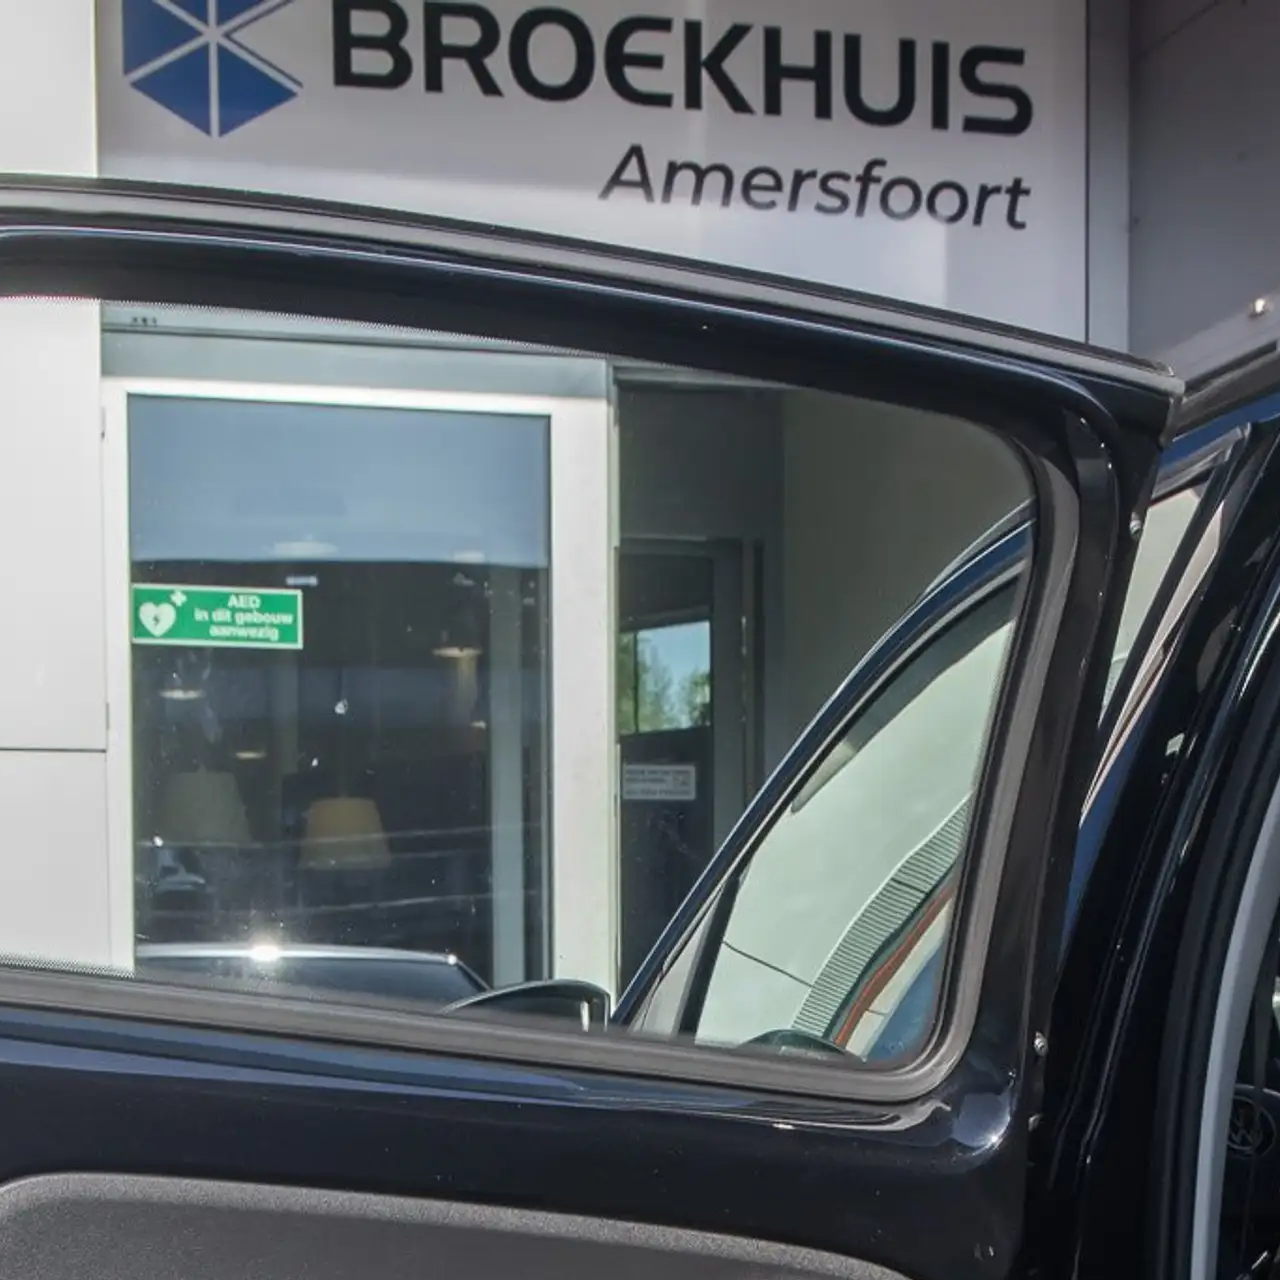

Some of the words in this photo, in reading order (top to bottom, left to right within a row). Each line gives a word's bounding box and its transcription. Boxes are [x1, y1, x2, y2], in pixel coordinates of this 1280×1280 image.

[332, 0, 1034, 137] BROEKHUIS
[597, 143, 1031, 230] Amersfoort
[228, 594, 261, 608] AED
[195, 608, 209, 621] in
[213, 608, 232, 622] dit
[236, 611, 293, 625] gebouw
[210, 626, 279, 641] aanwezig
